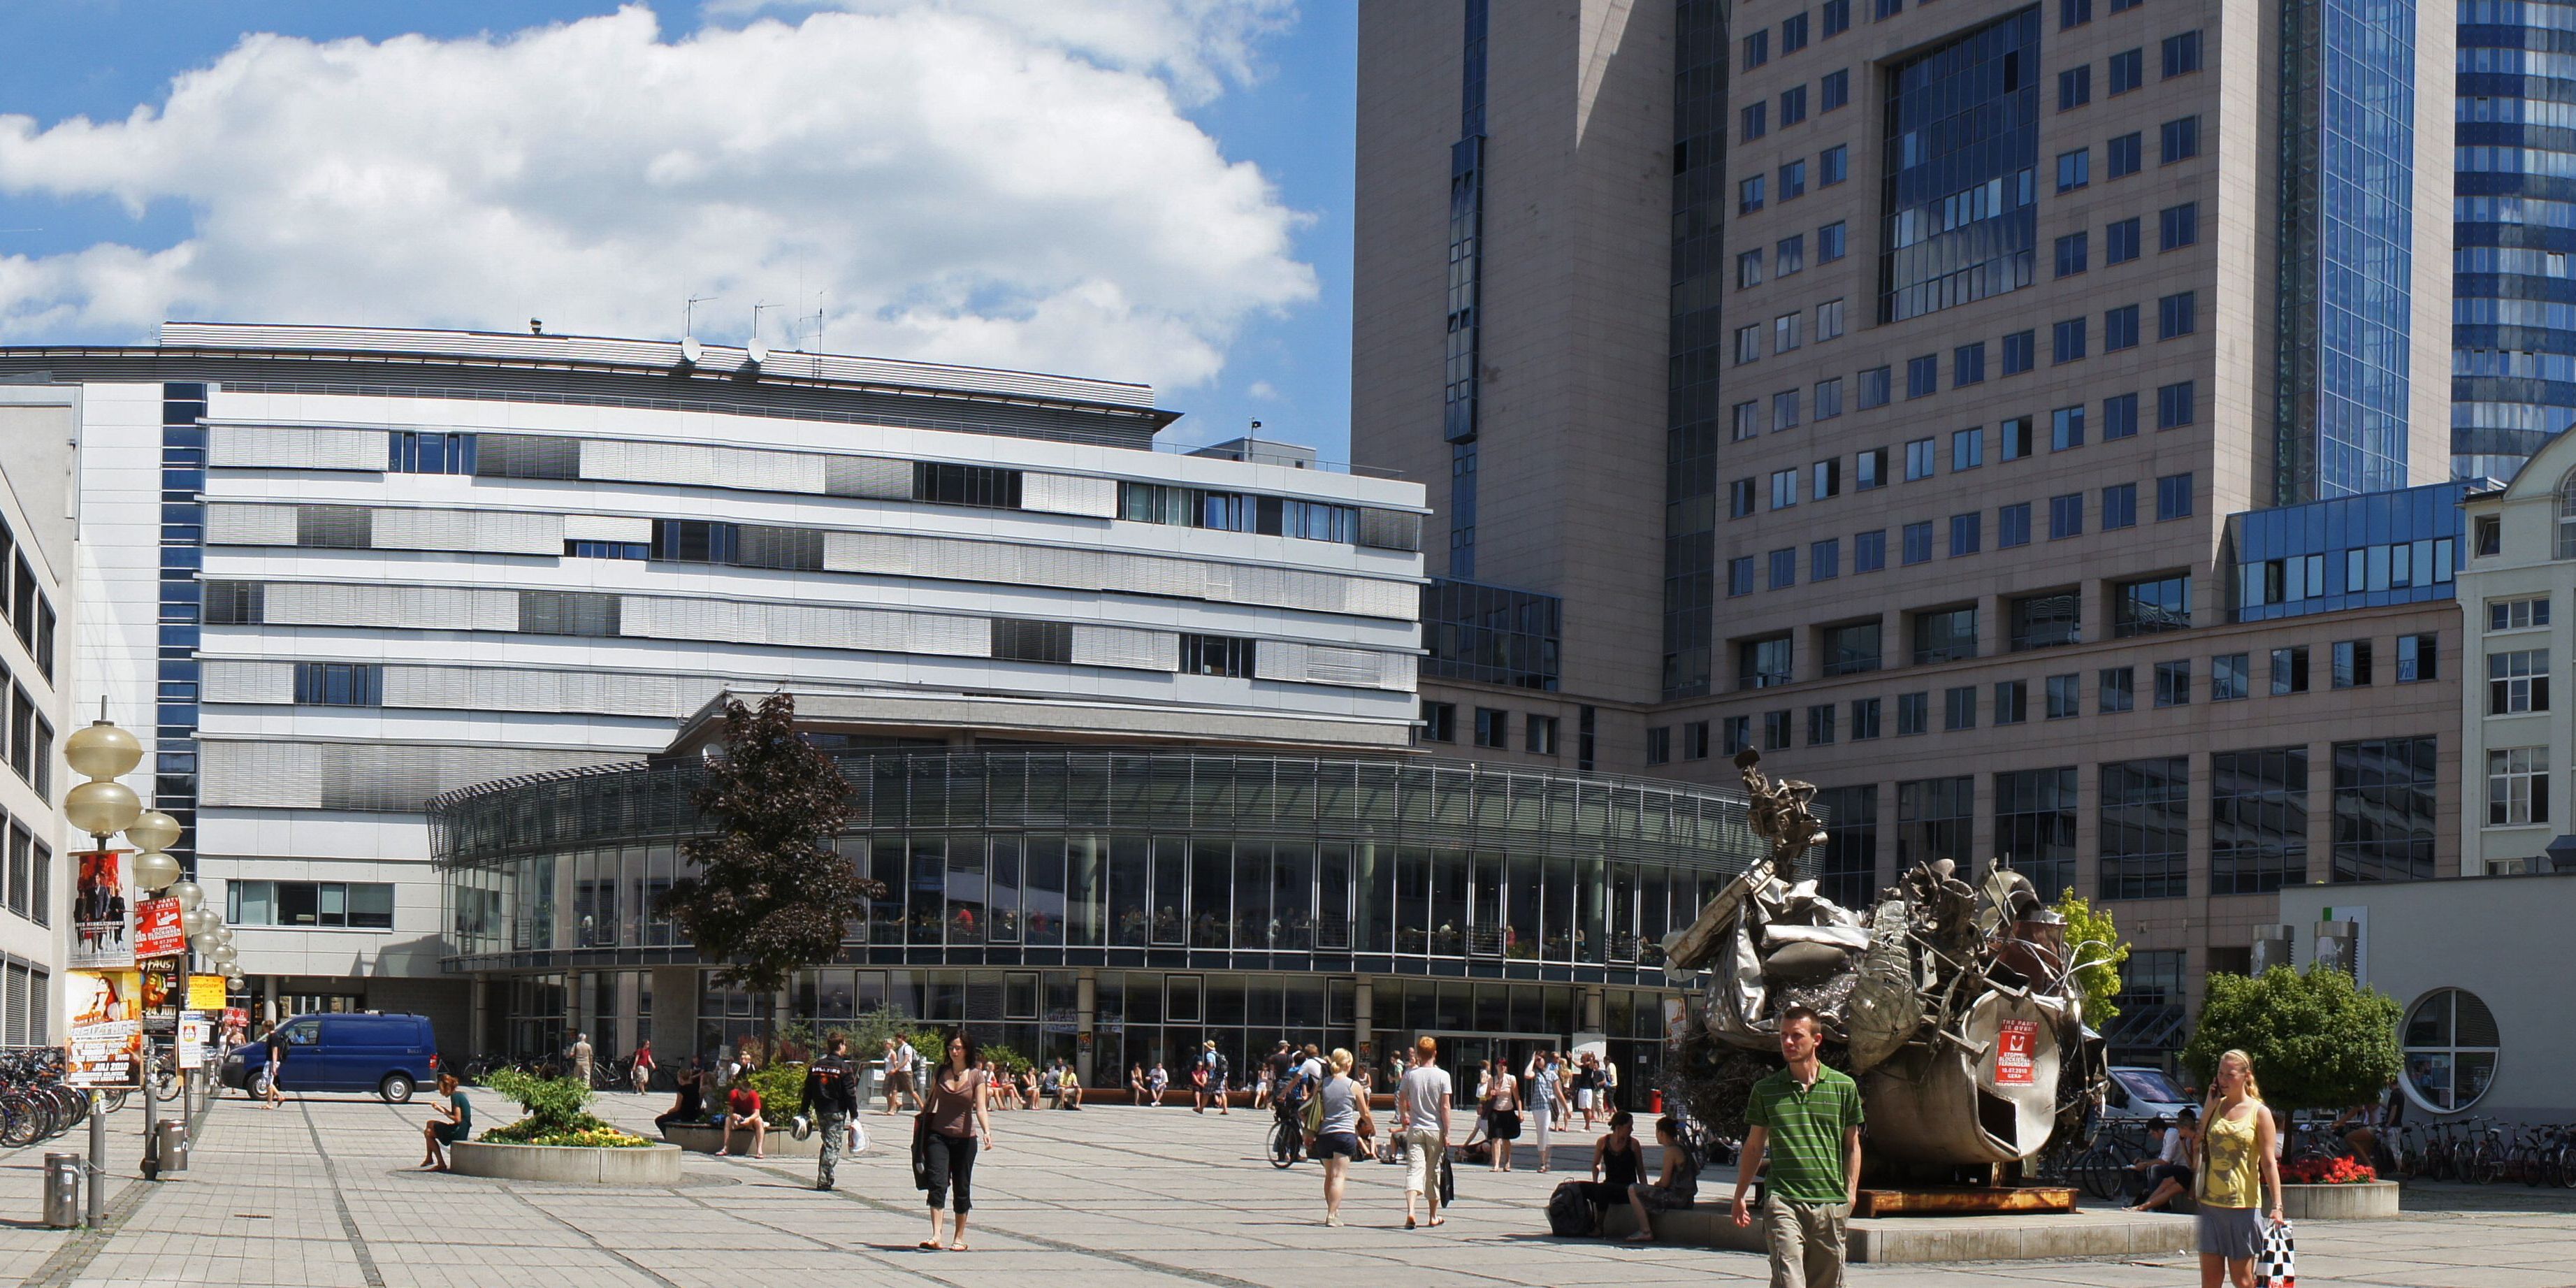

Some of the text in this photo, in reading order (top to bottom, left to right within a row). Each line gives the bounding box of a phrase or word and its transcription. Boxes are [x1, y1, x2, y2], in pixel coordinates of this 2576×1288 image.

[161, 1006, 176, 1015] JULI
[92, 1063, 110, 1071] JULI
[110, 1062, 129, 1071] 2010
